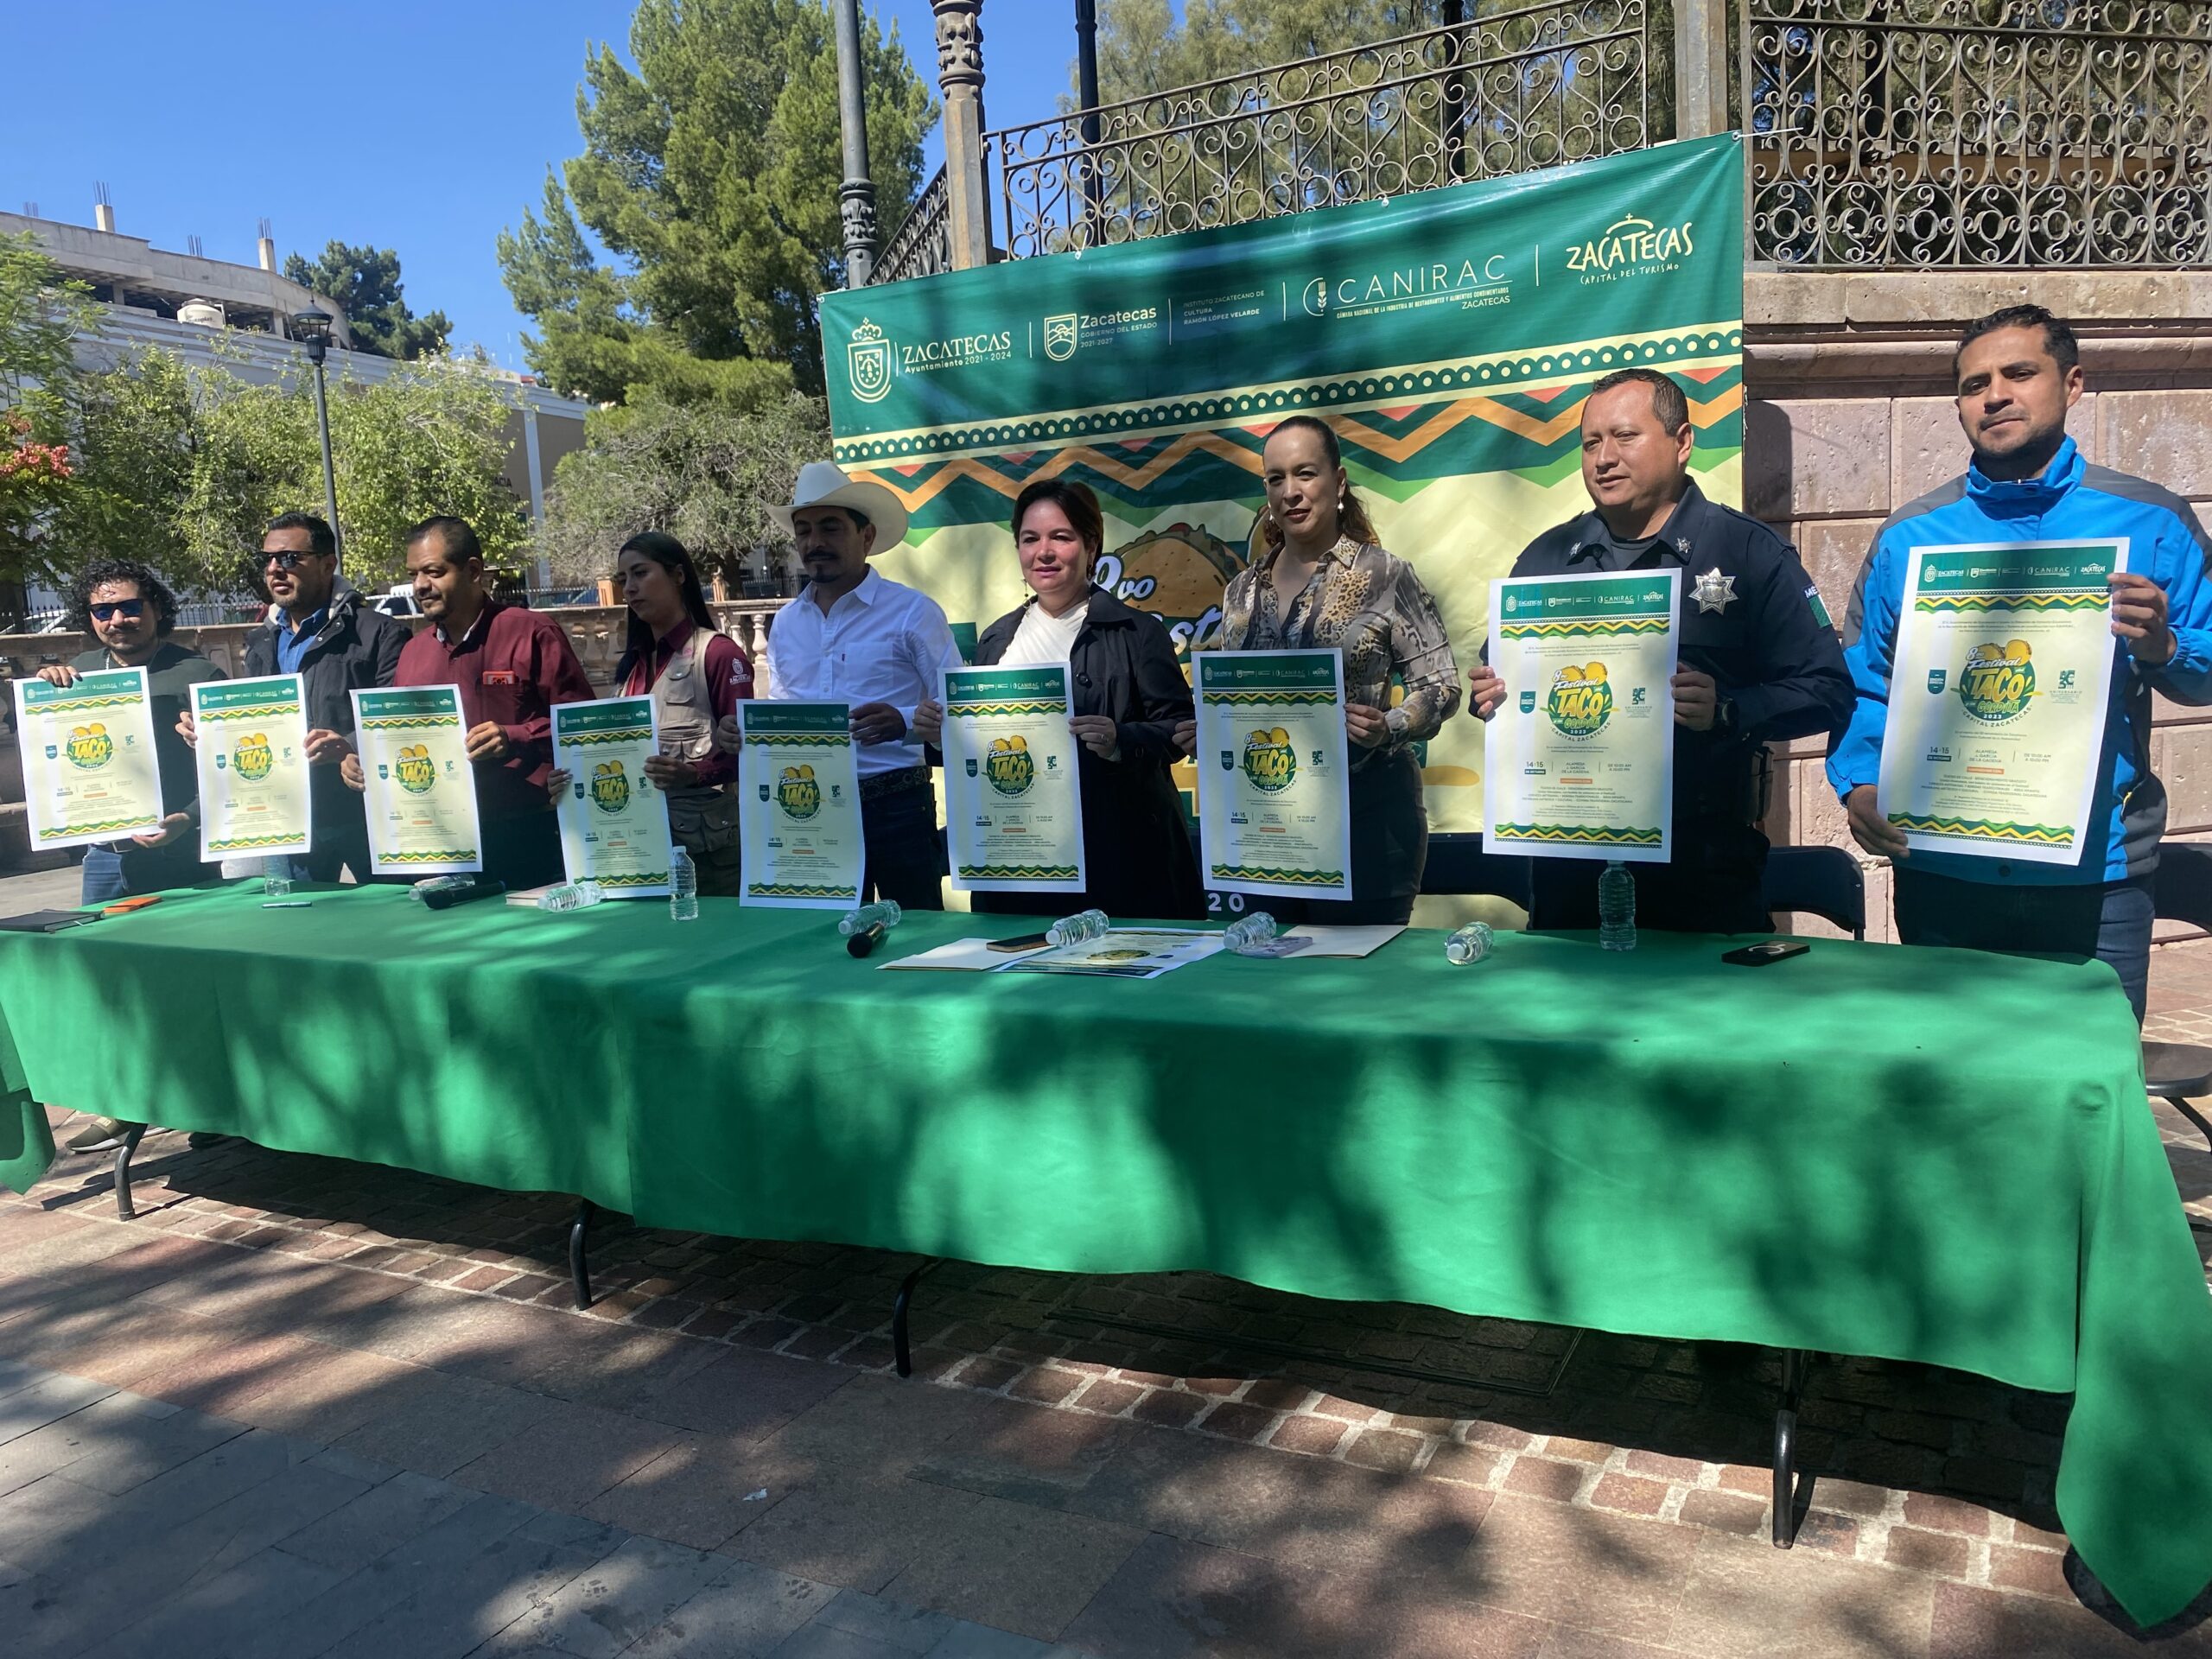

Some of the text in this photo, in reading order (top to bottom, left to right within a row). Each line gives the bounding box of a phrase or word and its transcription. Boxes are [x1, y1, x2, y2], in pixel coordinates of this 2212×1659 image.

[1566, 222, 1694, 272] ZACATECAS
[1338, 254, 1505, 303] CANIRAC
[1580, 264, 1679, 285] CAPITAL DEL TURISMO
[1214, 292, 1255, 304] ZACATECANO
[1461, 295, 1510, 310] ZACATECAS
[1080, 306, 1157, 329] Zacatecas
[1184, 308, 1213, 317] CULTURA
[1230, 308, 1260, 319] VELARDE
[1080, 328, 1116, 339] GOBIERNO
[1130, 321, 1158, 332] ESTADO
[902, 331, 1011, 365] ZACATECAS
[905, 359, 963, 374] Ayuntamiento
[964, 354, 984, 365] 2021
[990, 350, 1012, 361] 2024
[1967, 658, 2023, 671] Festival
[1554, 678, 1599, 690] Festival
[1971, 668, 2026, 702] TACO
[1557, 687, 1604, 719] TACO
[1962, 706, 2032, 728] CAPITAL ZACATECAS
[1551, 721, 1611, 742] CAPITAL ZACATECAS
[72, 738, 107, 759] TACO
[1247, 741, 1282, 752] Festival
[238, 749, 268, 770] TACO
[992, 755, 1027, 780] TACO
[1250, 749, 1289, 777] TACO
[400, 761, 430, 782] TACO
[596, 779, 625, 801] TACO
[783, 783, 815, 805] TACO
[1249, 779, 1297, 797] CAPITAL ZACATECAS
[1207, 893, 1245, 912] 20
